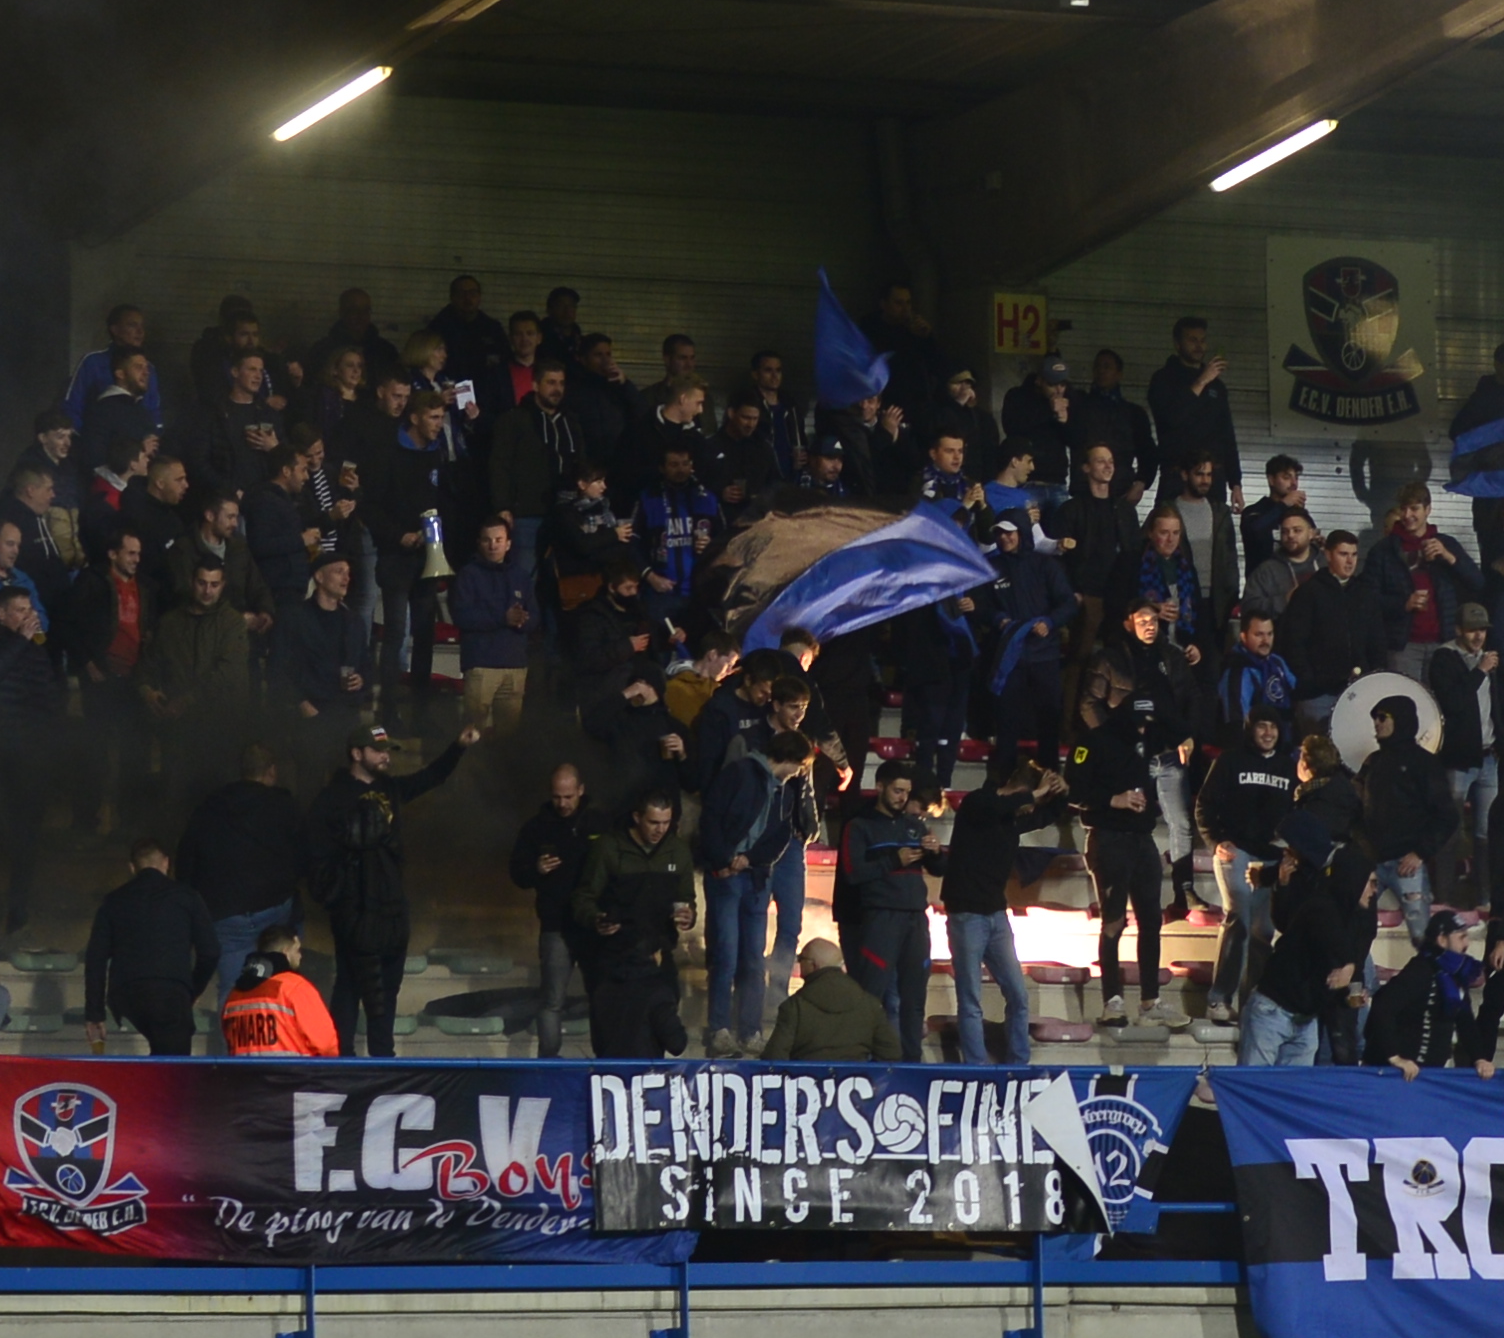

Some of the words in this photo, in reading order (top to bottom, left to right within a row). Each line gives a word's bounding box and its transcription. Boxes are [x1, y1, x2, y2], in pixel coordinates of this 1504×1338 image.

[996, 303, 1041, 349] H2
[1334, 390, 1383, 420] DENDER
[590, 1072, 876, 1165] DENDER'S
[660, 1165, 855, 1225] SINCE
[906, 1169, 1065, 1225] 2018
[357, 1206, 412, 1231] van
